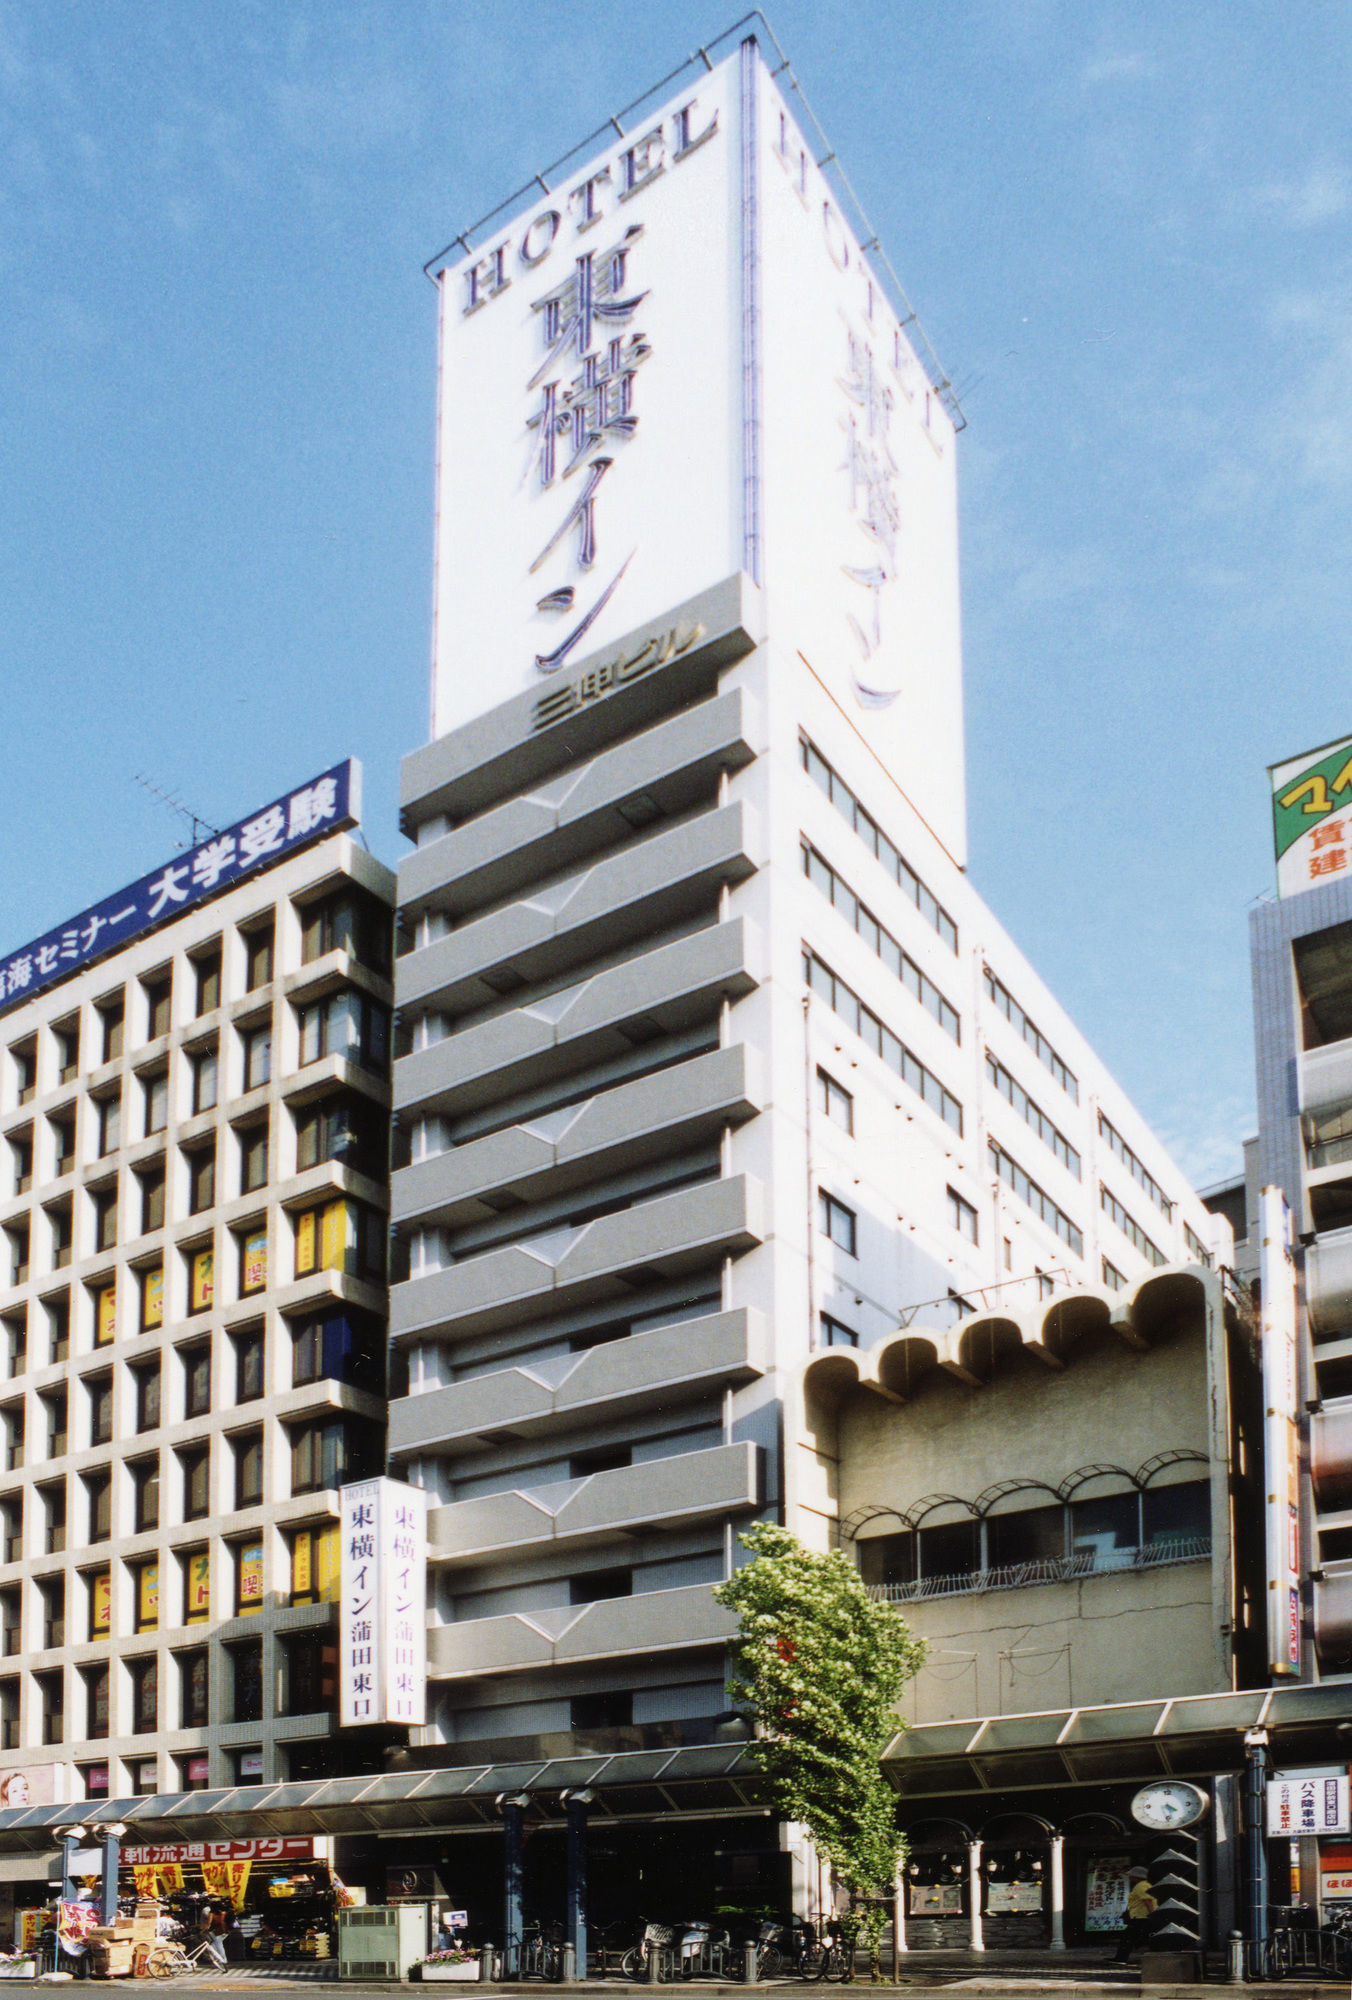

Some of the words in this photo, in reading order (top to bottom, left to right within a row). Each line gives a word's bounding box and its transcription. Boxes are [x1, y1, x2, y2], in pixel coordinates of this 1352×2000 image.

[461, 97, 720, 316] HOTEL
[771, 97, 944, 460] HOTEL
[520, 222, 653, 673] 東横イン
[147, 777, 339, 918] 大学受験
[345, 1483, 380, 1502] HOTEL
[118, 1838, 309, 1864] 靴流通センター
[1301, 1781, 1315, 1827] バス降車場
